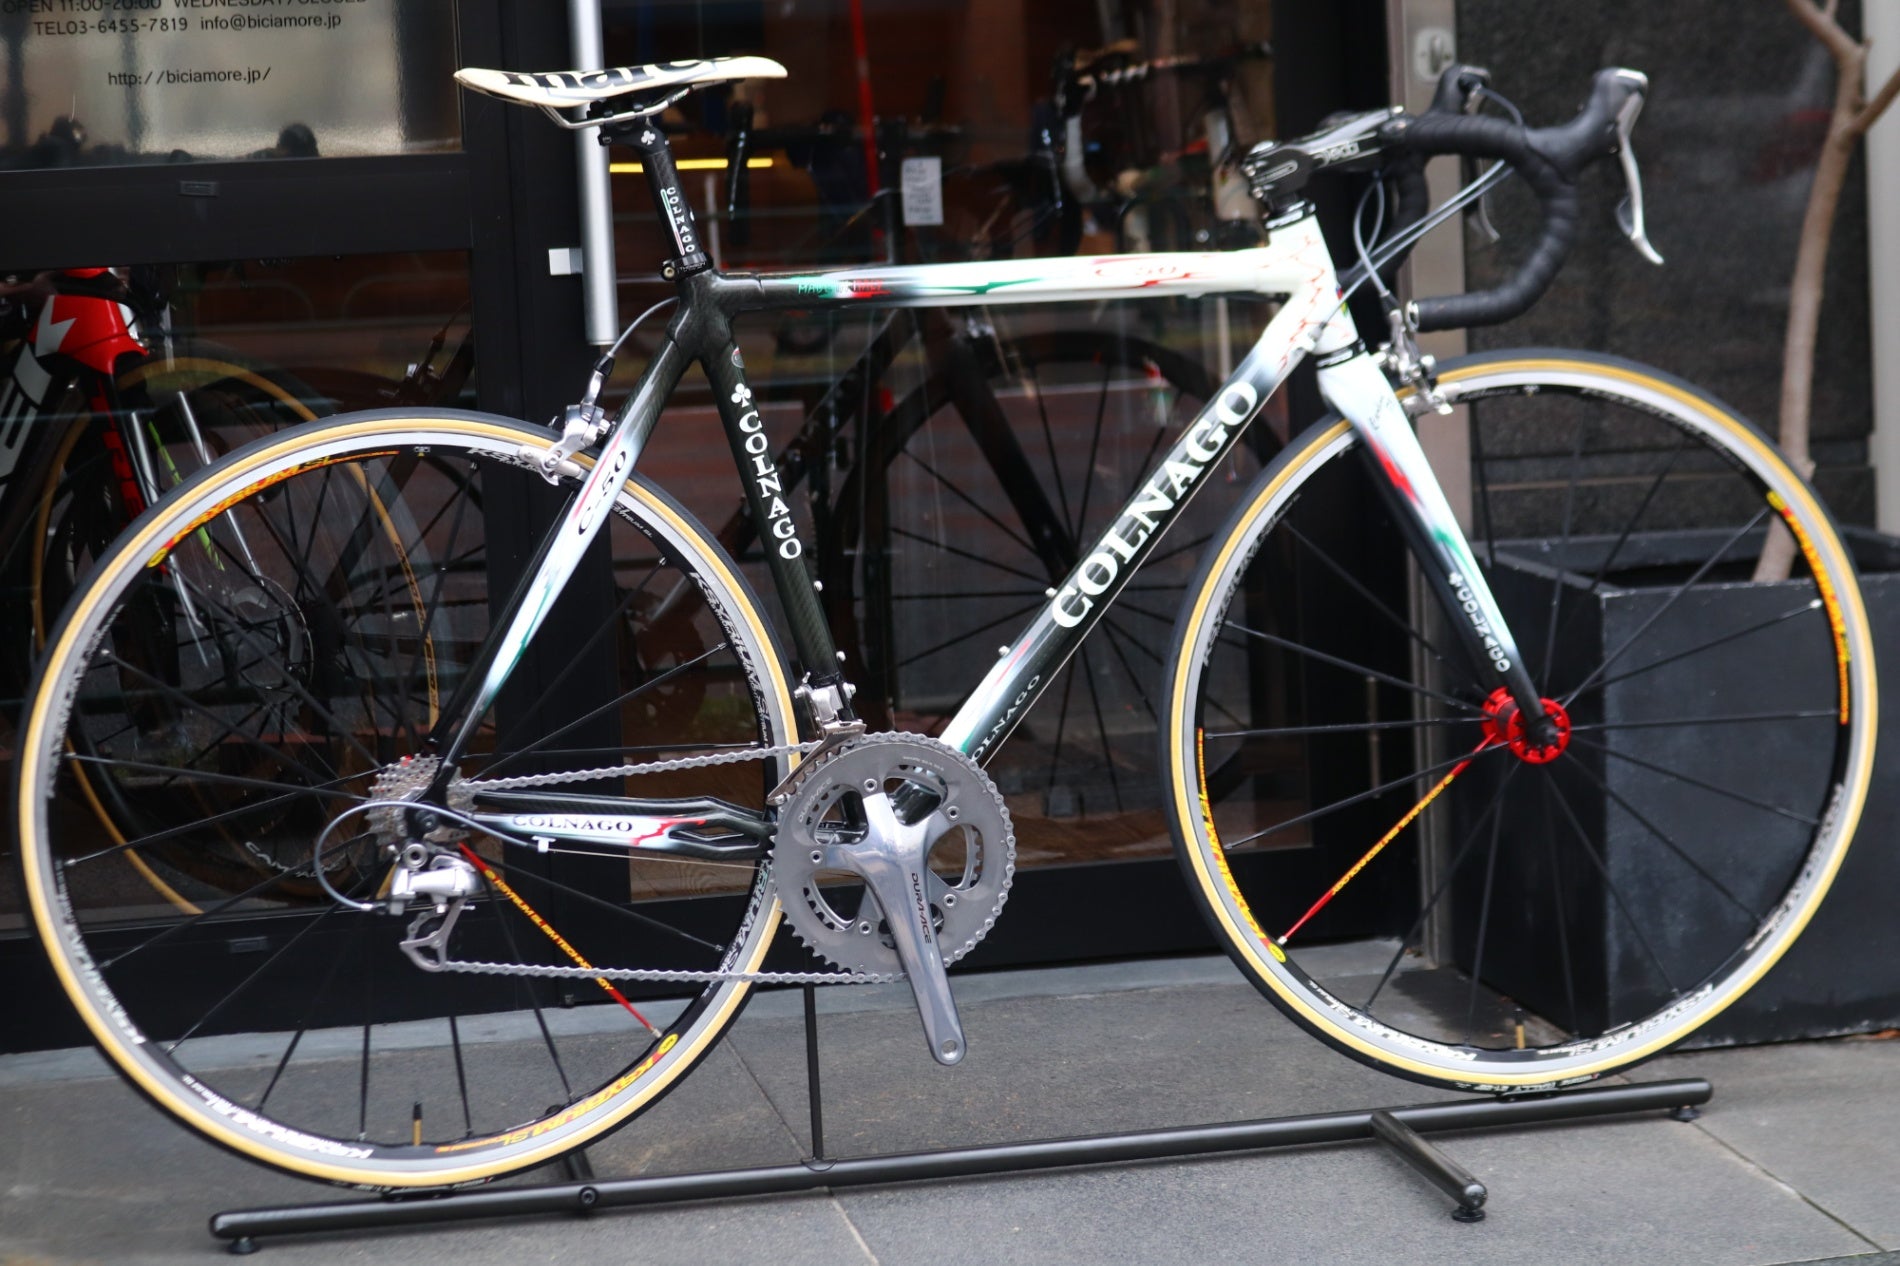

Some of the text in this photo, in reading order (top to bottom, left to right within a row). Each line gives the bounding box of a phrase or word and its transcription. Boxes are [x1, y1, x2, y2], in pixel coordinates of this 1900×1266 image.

[3, 0, 53, 13] OPEN
[34, 12, 342, 35] TEL03-6455-7819 info@biciamore.jp
[107, 67, 272, 87] http://biciamore.jp/
[666, 187, 695, 253] COLNAGO
[738, 410, 802, 560] COLNAGO
[1051, 381, 1258, 628] COLNAGO
[1456, 585, 1511, 673] COLNAGO
[970, 674, 1041, 763] OLNAGO
[512, 815, 633, 832] COLNAGO
[911, 872, 932, 944] DURA-ACE
